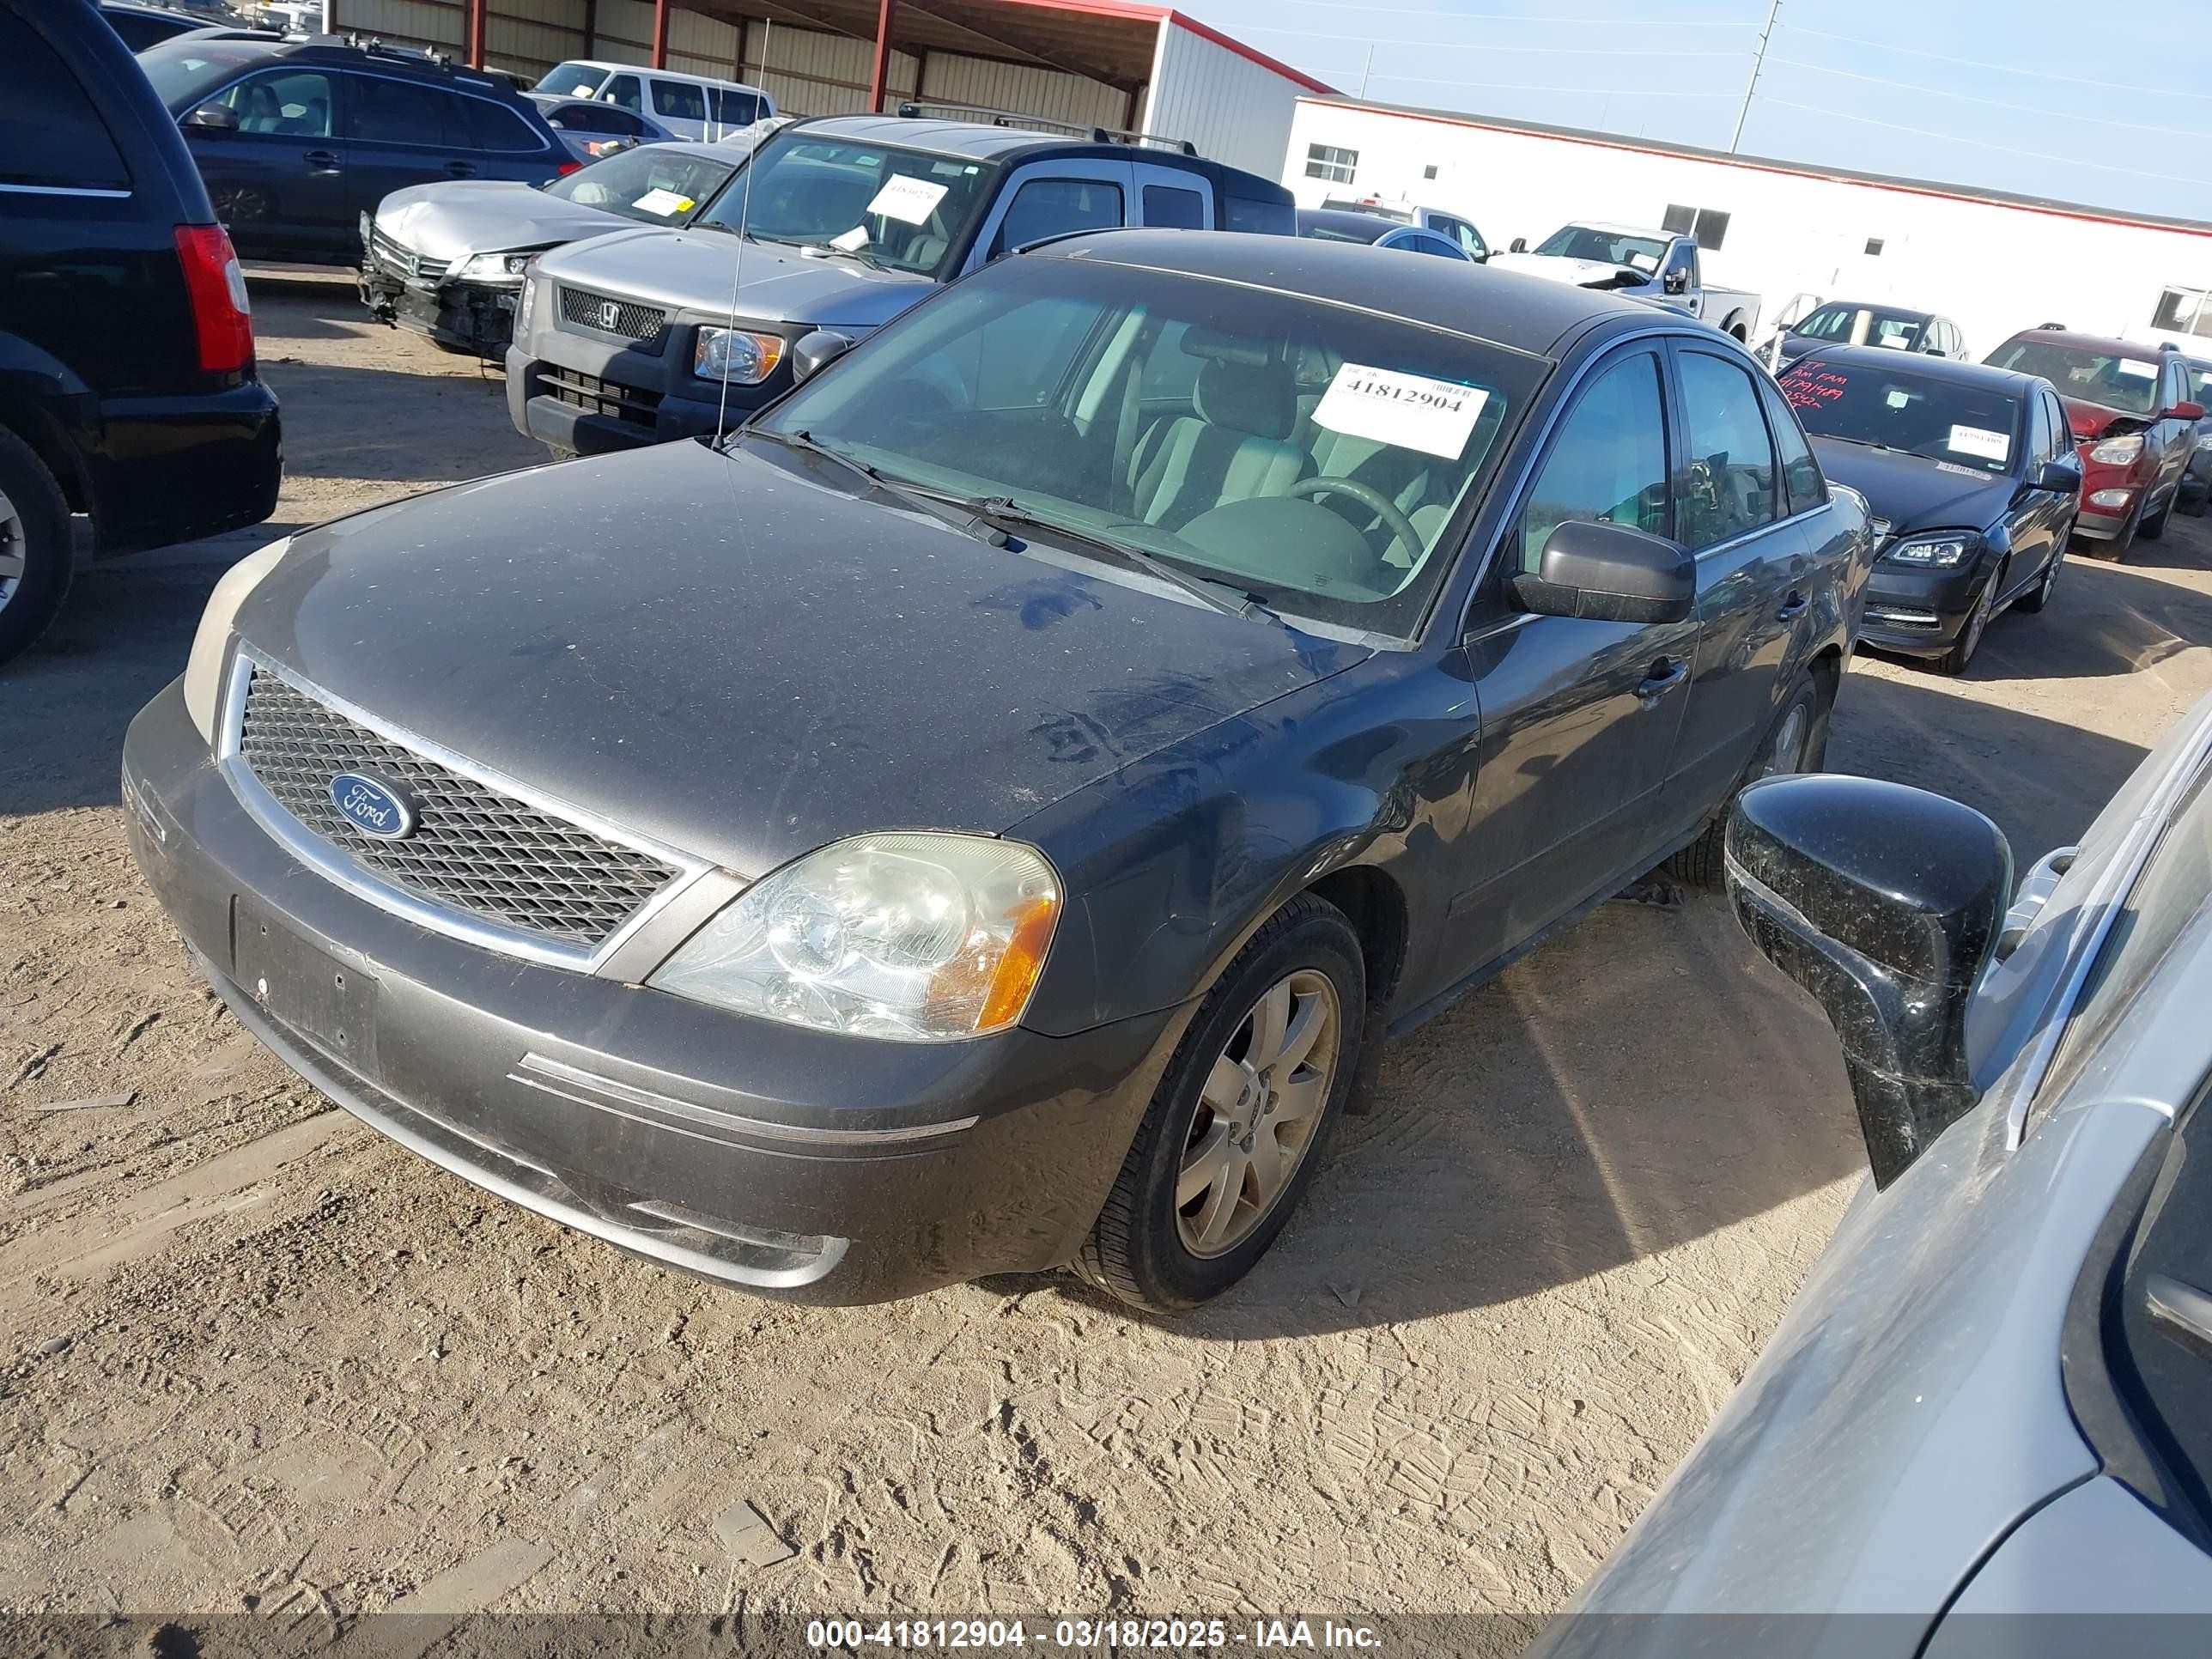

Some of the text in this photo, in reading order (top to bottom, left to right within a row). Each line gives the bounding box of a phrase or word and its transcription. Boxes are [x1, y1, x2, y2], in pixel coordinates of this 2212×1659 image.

[1790, 368, 1848, 385] AM FAM
[1347, 380, 1462, 412] 41812904
[343, 785, 391, 827] Ford
